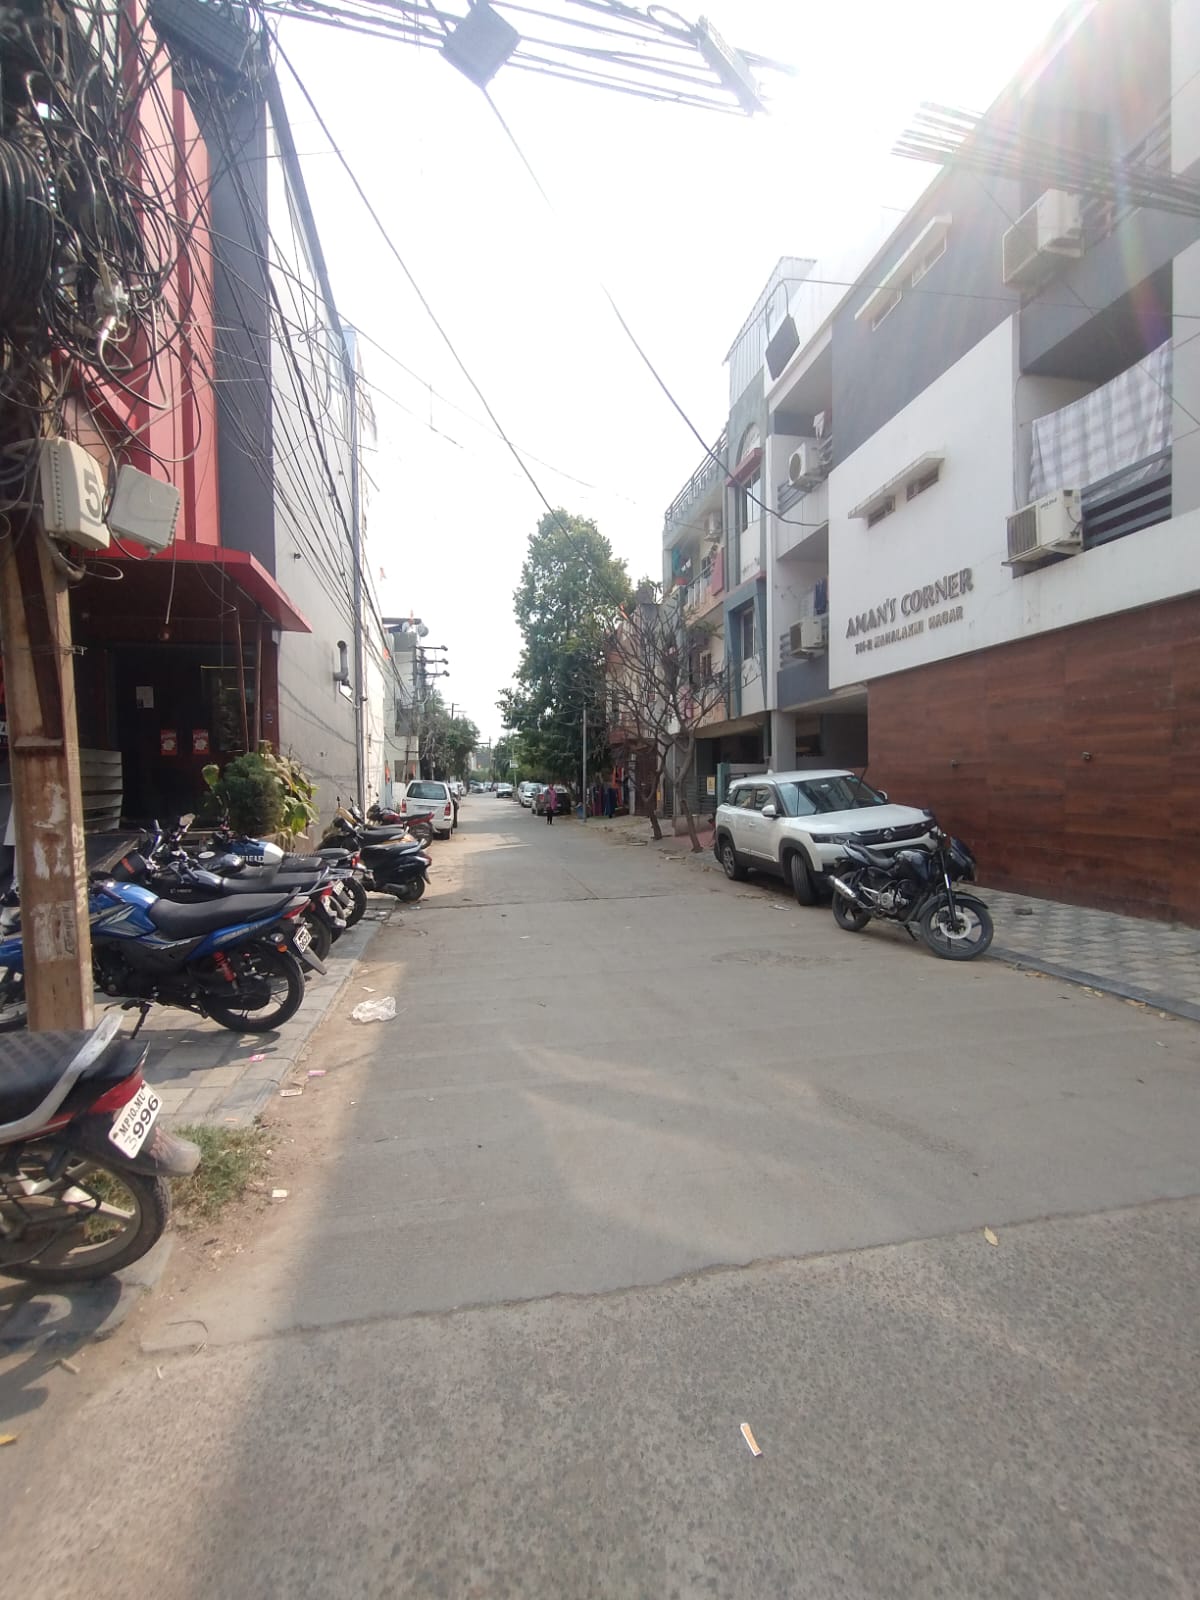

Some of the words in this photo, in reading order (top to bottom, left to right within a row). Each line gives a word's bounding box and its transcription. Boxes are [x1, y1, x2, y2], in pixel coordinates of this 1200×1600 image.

[83, 468, 101, 519] 5
[846, 597, 897, 639] AMAN'S
[900, 567, 975, 617] CORNER
[240, 855, 265, 863] FIELD
